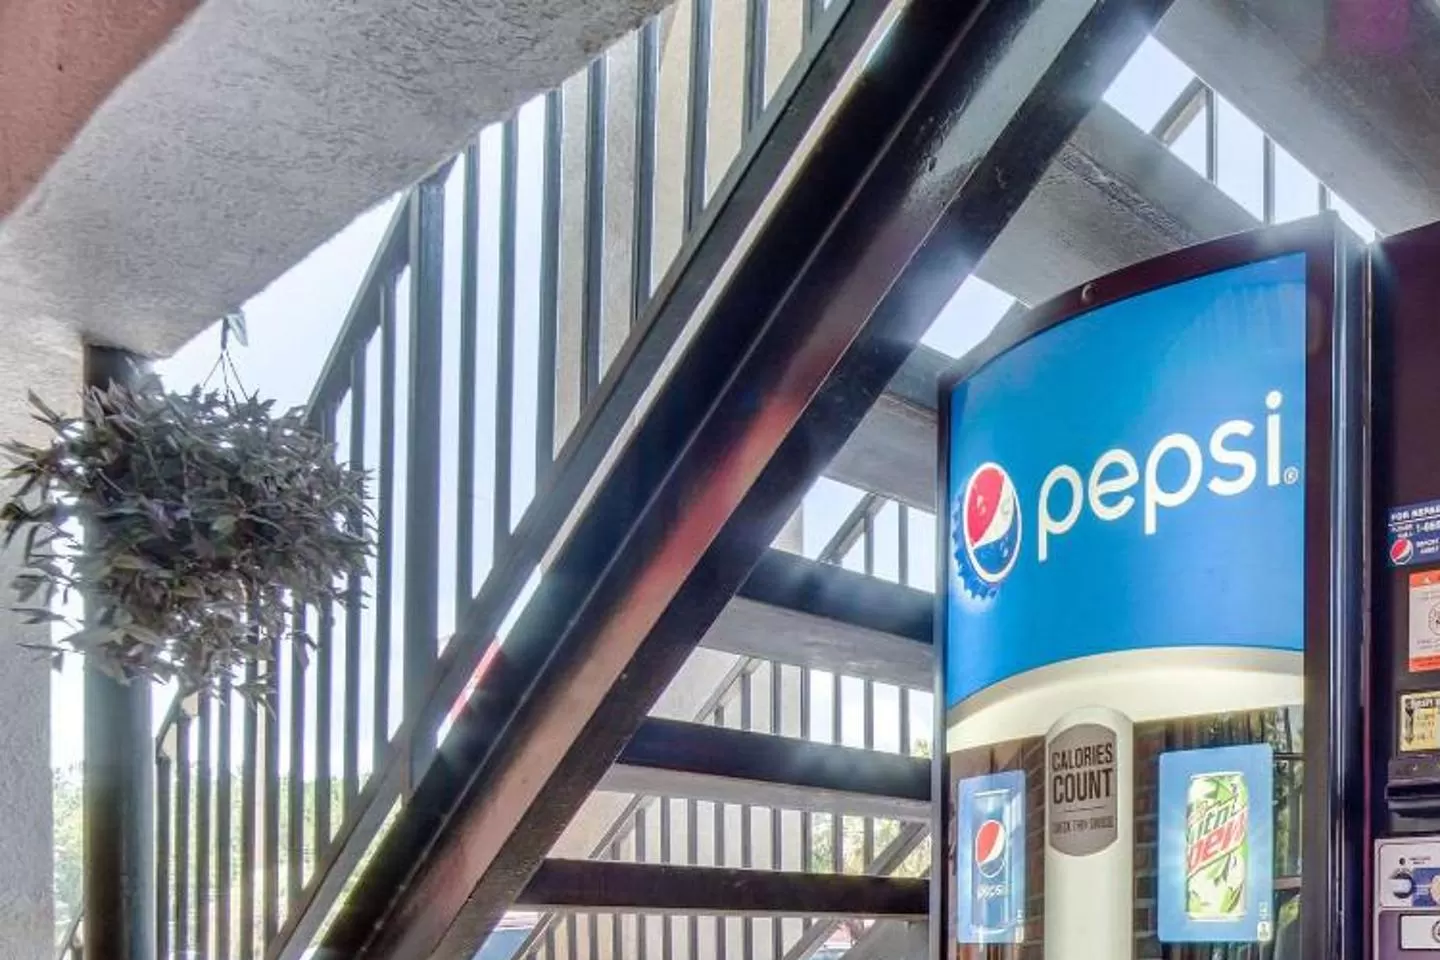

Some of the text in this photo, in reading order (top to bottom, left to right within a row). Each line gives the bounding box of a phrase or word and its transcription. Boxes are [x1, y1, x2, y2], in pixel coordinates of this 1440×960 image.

[1037, 390, 1284, 562] pepsi
[1391, 511, 1409, 521] FOR
[1052, 742, 1113, 771] CALORIES
[1053, 768, 1113, 804] COUNT
